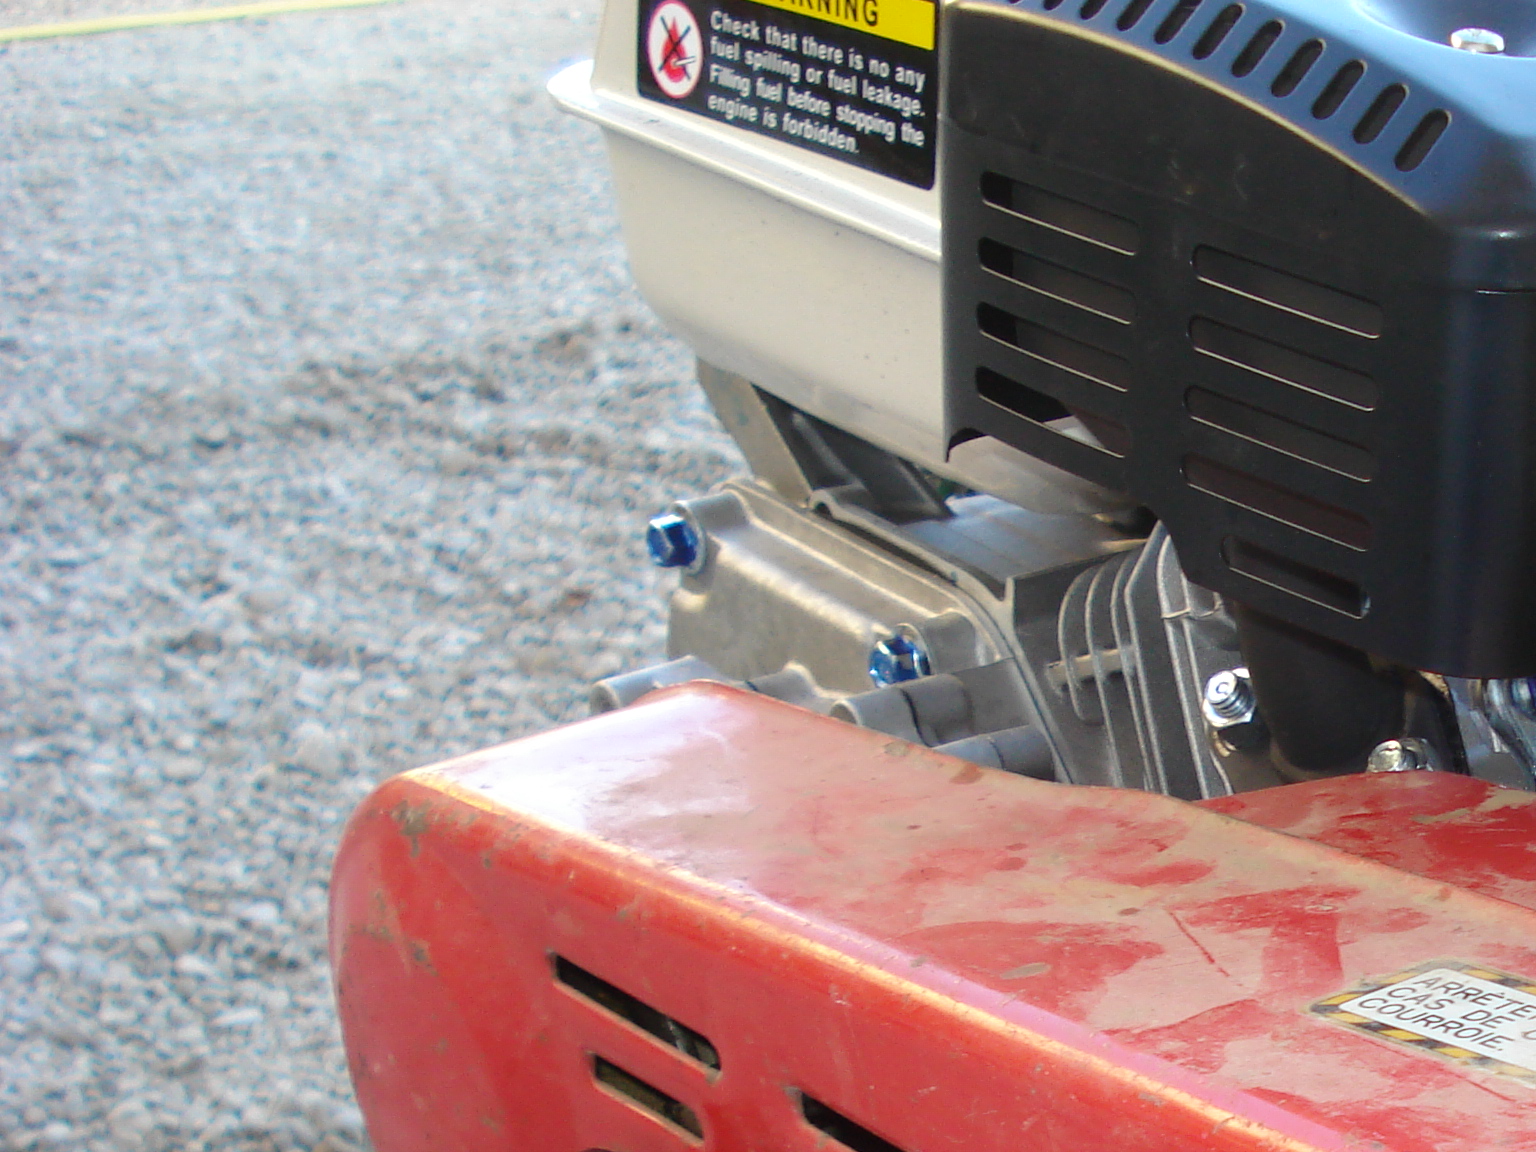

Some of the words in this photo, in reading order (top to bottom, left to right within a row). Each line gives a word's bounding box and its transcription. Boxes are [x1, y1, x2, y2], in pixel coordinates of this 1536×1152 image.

[780, 0, 878, 26] NING
[710, 10, 760, 41] Check
[765, 25, 798, 51] that
[802, 35, 844, 64] there
[849, 48, 865, 69] is
[869, 59, 890, 78] no
[895, 66, 926, 93] any
[710, 35, 740, 61] fuel
[744, 50, 801, 83] spilling
[805, 66, 824, 85] or
[828, 68, 858, 95] fuel
[862, 79, 926, 118] leakage.
[708, 94, 758, 122] engine
[763, 106, 778, 128] is
[782, 112, 860, 154] forbidden.
[709, 64, 751, 97] Filling
[756, 77, 783, 103] fuel
[787, 86, 831, 117] before
[836, 104, 896, 143] stopping
[900, 122, 926, 147] the
[1358, 998, 1516, 1051] COURROIE.
[1387, 987, 1454, 1011] CAS
[1460, 1009, 1516, 1029] DE
